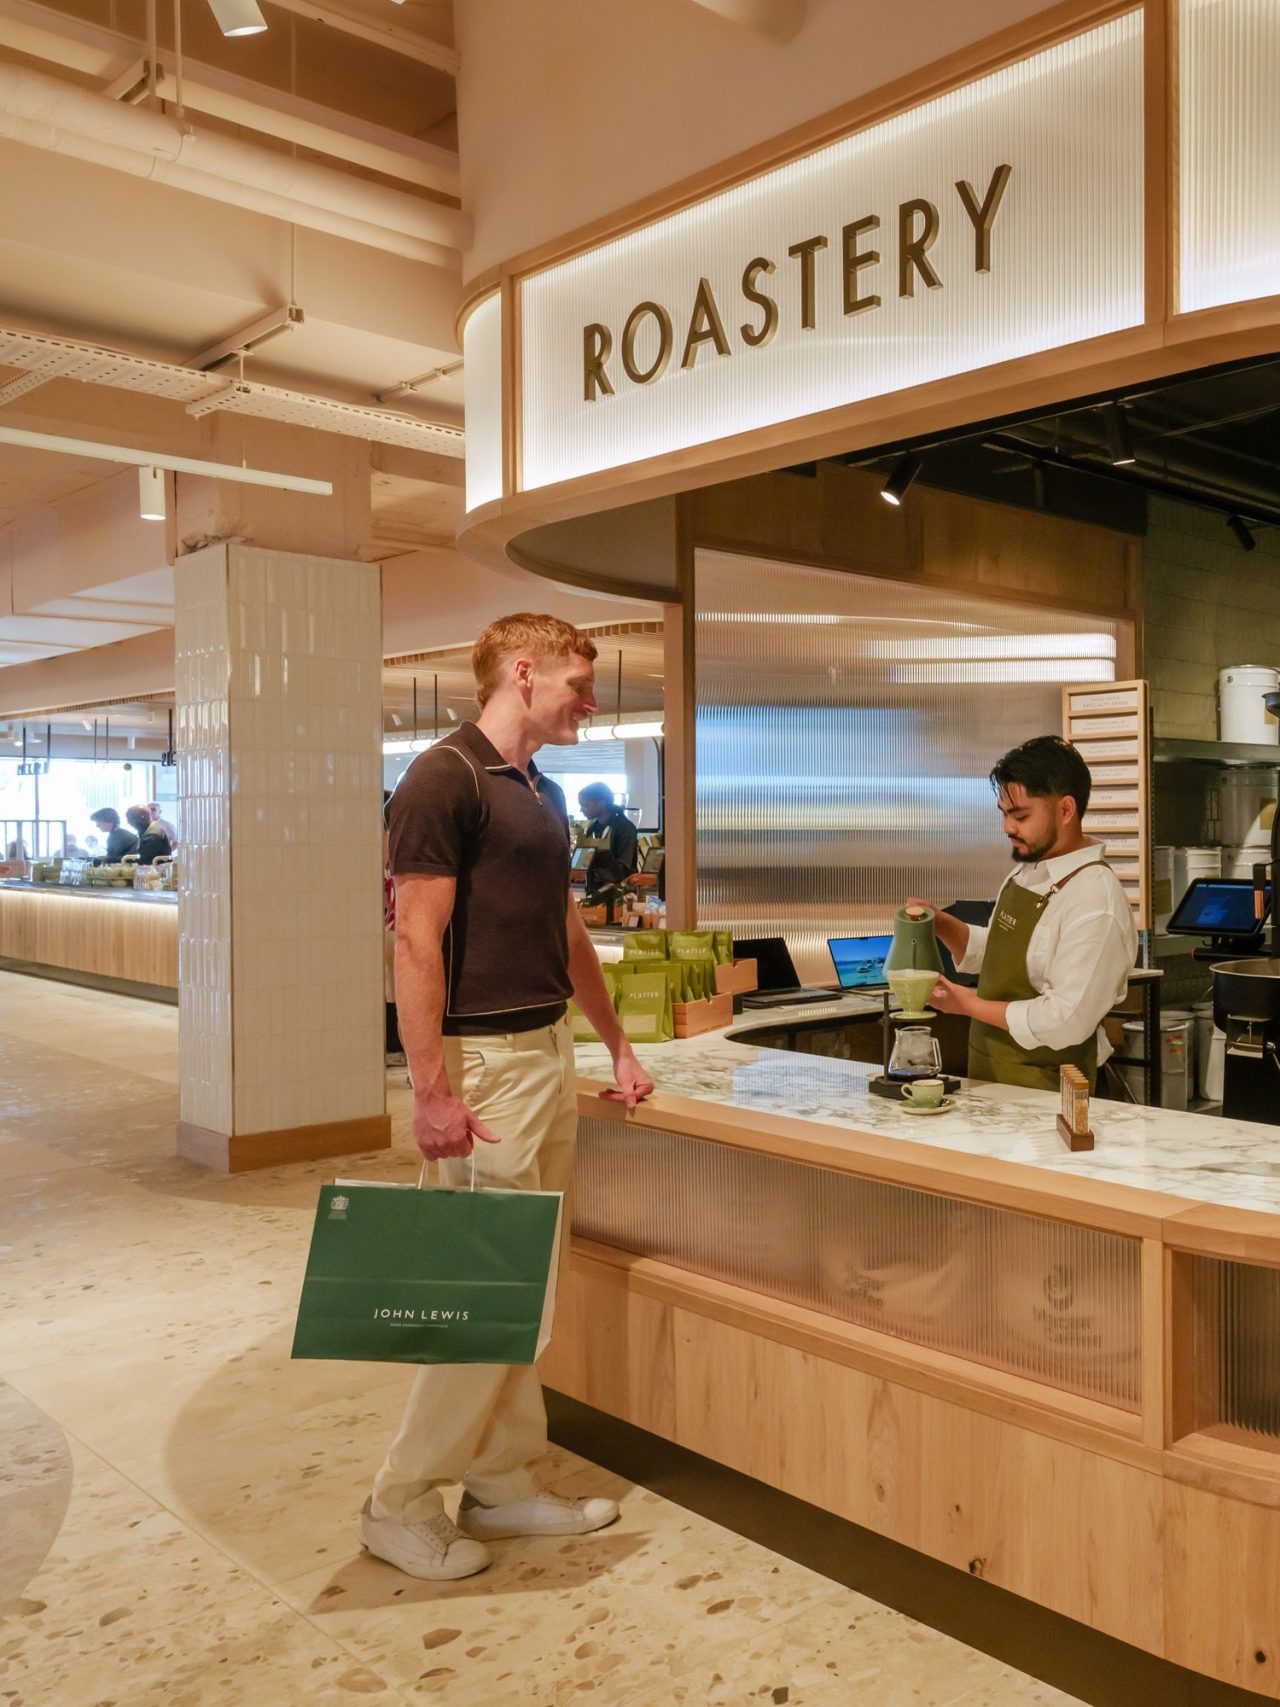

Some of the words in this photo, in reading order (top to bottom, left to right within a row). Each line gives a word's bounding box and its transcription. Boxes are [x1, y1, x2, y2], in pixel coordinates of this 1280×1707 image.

[583, 163, 1013, 402] ROASTERY
[629, 991, 660, 999] PLATTER
[373, 1308, 415, 1319] JOHN
[421, 1310, 469, 1320] LEWIS
